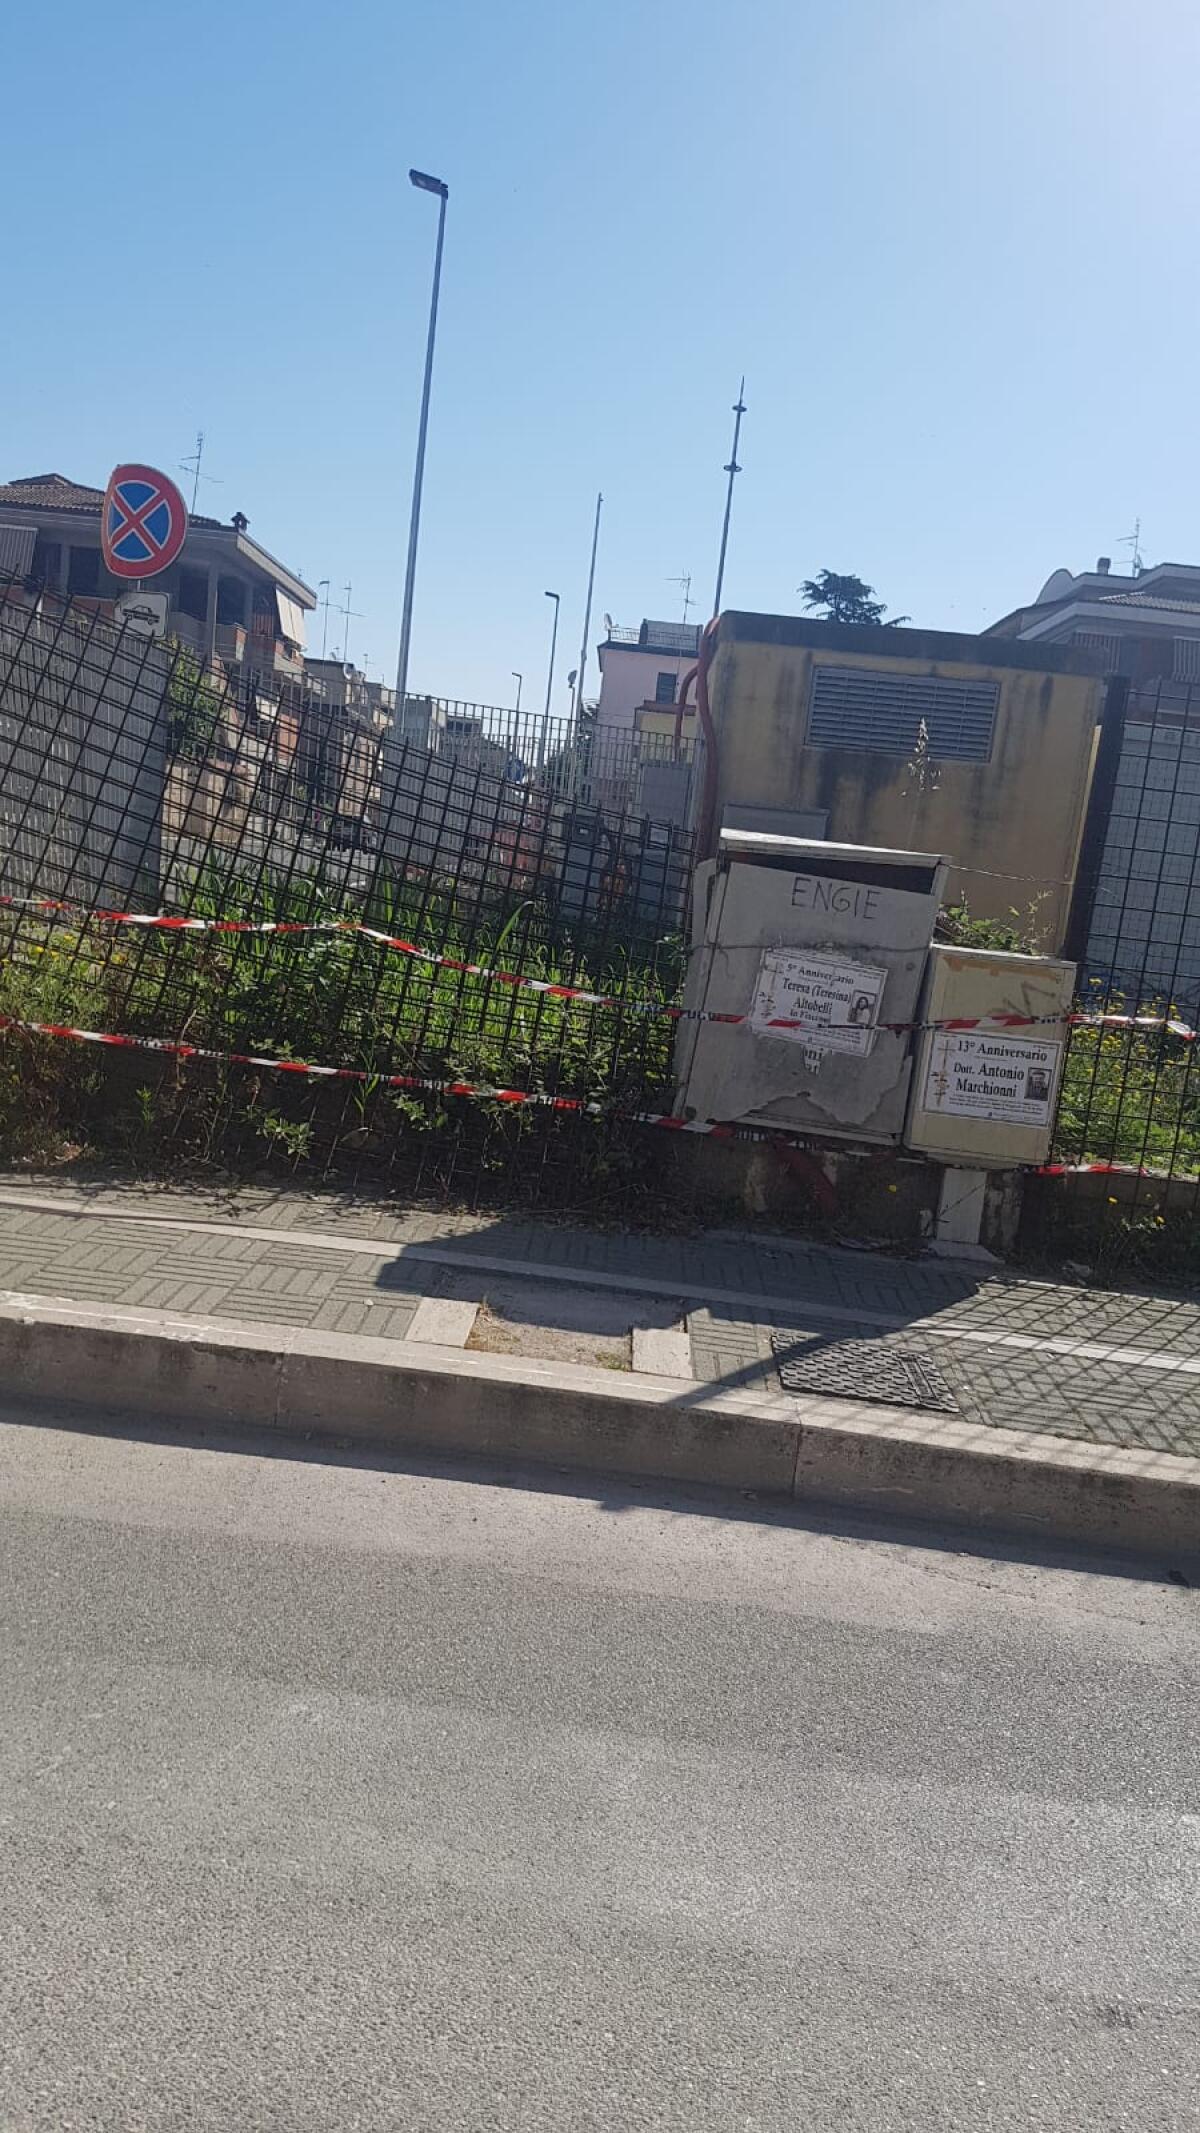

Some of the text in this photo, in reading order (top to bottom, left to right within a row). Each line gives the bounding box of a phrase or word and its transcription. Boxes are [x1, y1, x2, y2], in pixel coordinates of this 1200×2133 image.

[792, 876, 882, 919] ENGIE
[783, 978, 810, 994] Teresa
[976, 1044, 1047, 1061] Anniversario
[954, 1062, 1024, 1080] Dott. Antonio
[956, 1078, 1017, 1097] Marchionni
